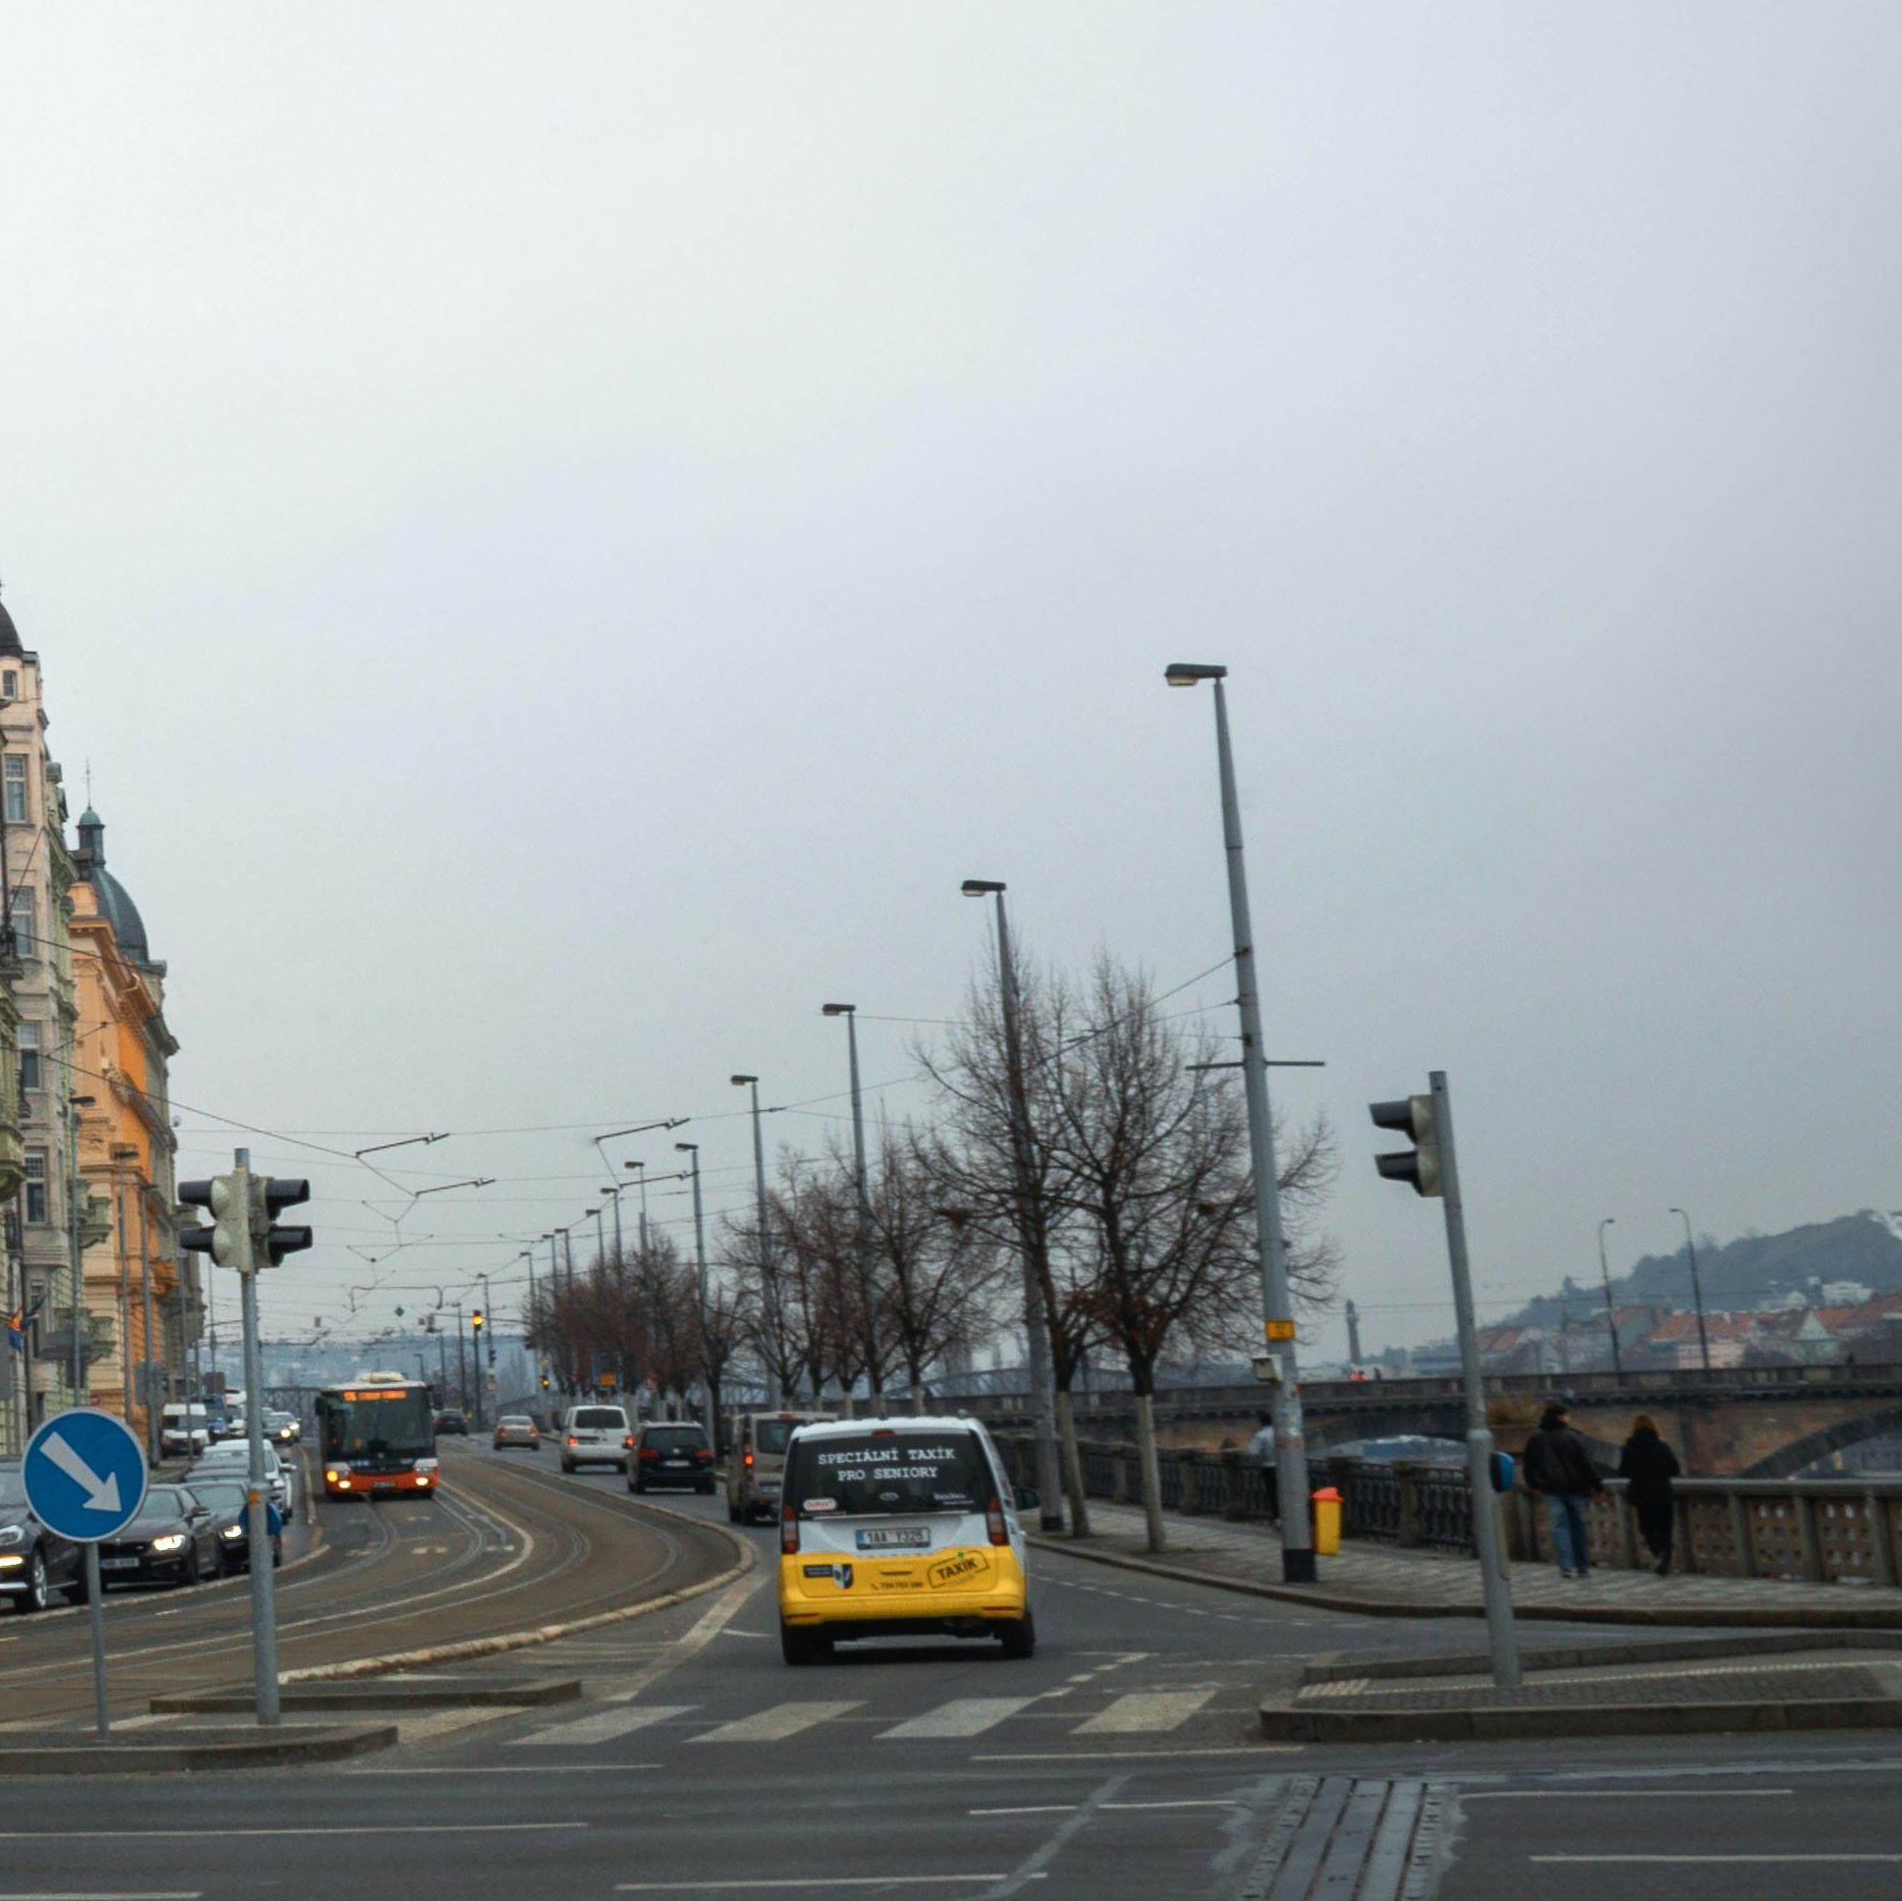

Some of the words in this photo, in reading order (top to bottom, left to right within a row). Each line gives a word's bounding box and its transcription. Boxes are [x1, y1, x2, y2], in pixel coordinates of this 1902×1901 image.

[818, 1447, 900, 1465] SPECIÁLNÍ
[907, 1445, 956, 1461] TAXÍK
[837, 1468, 867, 1482] PRO
[873, 1466, 939, 1480] SENIORY
